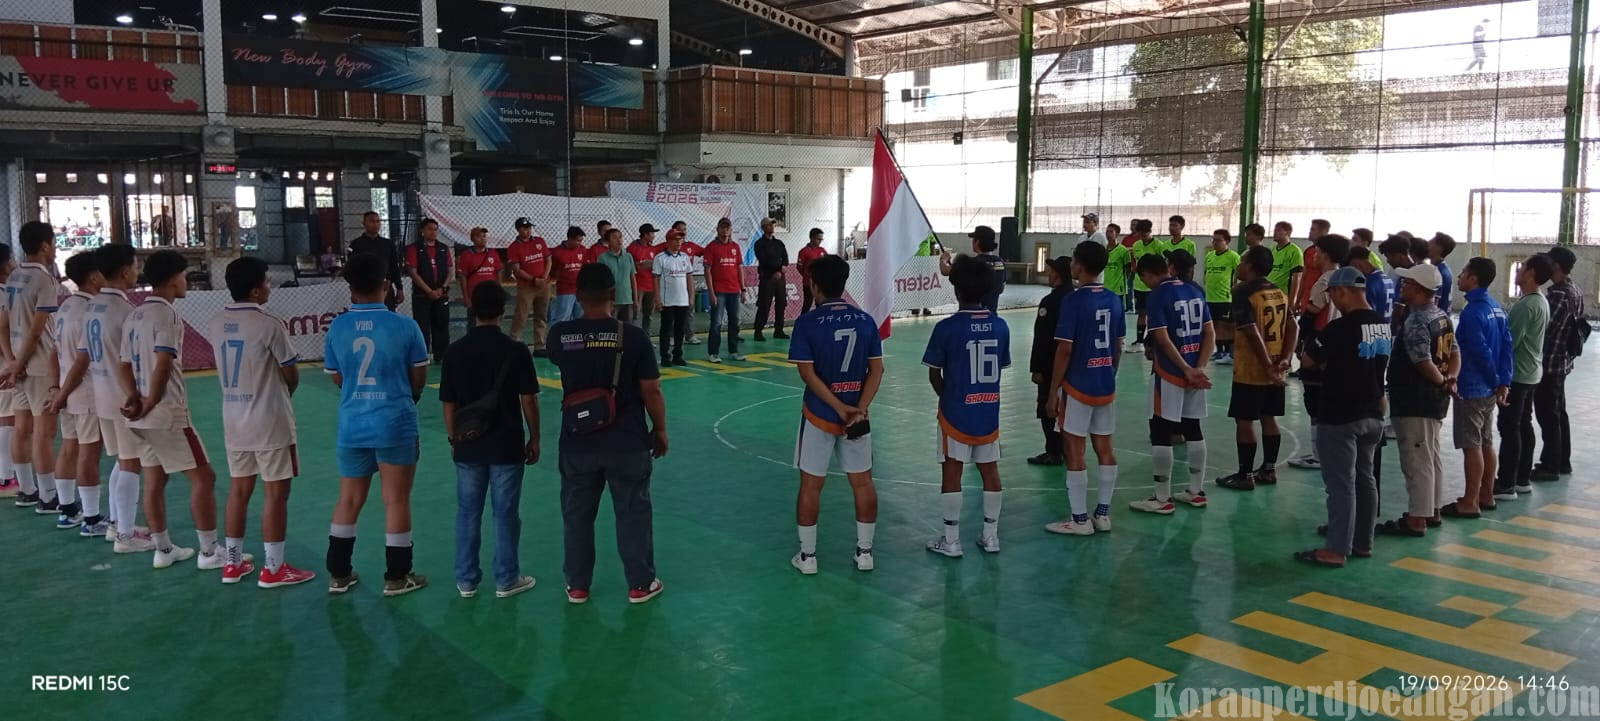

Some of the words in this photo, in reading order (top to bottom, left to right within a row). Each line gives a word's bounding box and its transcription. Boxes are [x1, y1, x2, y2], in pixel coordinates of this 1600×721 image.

[0, 72, 77, 90] NEVER
[86, 75, 137, 91] GIVE
[147, 77, 176, 93] UP
[279, 49, 327, 77] Body
[335, 53, 373, 78] Gym
[499, 116, 524, 124] Respect
[539, 117, 556, 126] Enjoy
[500, 107, 513, 115] This
[521, 108, 534, 116] Our
[535, 109, 555, 117] Home
[656, 193, 699, 204] 2026
[659, 183, 699, 193] PORSENI
[970, 322, 993, 332] CALIST
[1094, 308, 1111, 349] 3
[1174, 297, 1204, 338] 39
[1263, 303, 1286, 341] 27
[86, 318, 103, 362] 18
[834, 327, 857, 372] 7
[220, 339, 244, 388] 17
[352, 336, 377, 386] 2
[966, 339, 998, 384] 16
